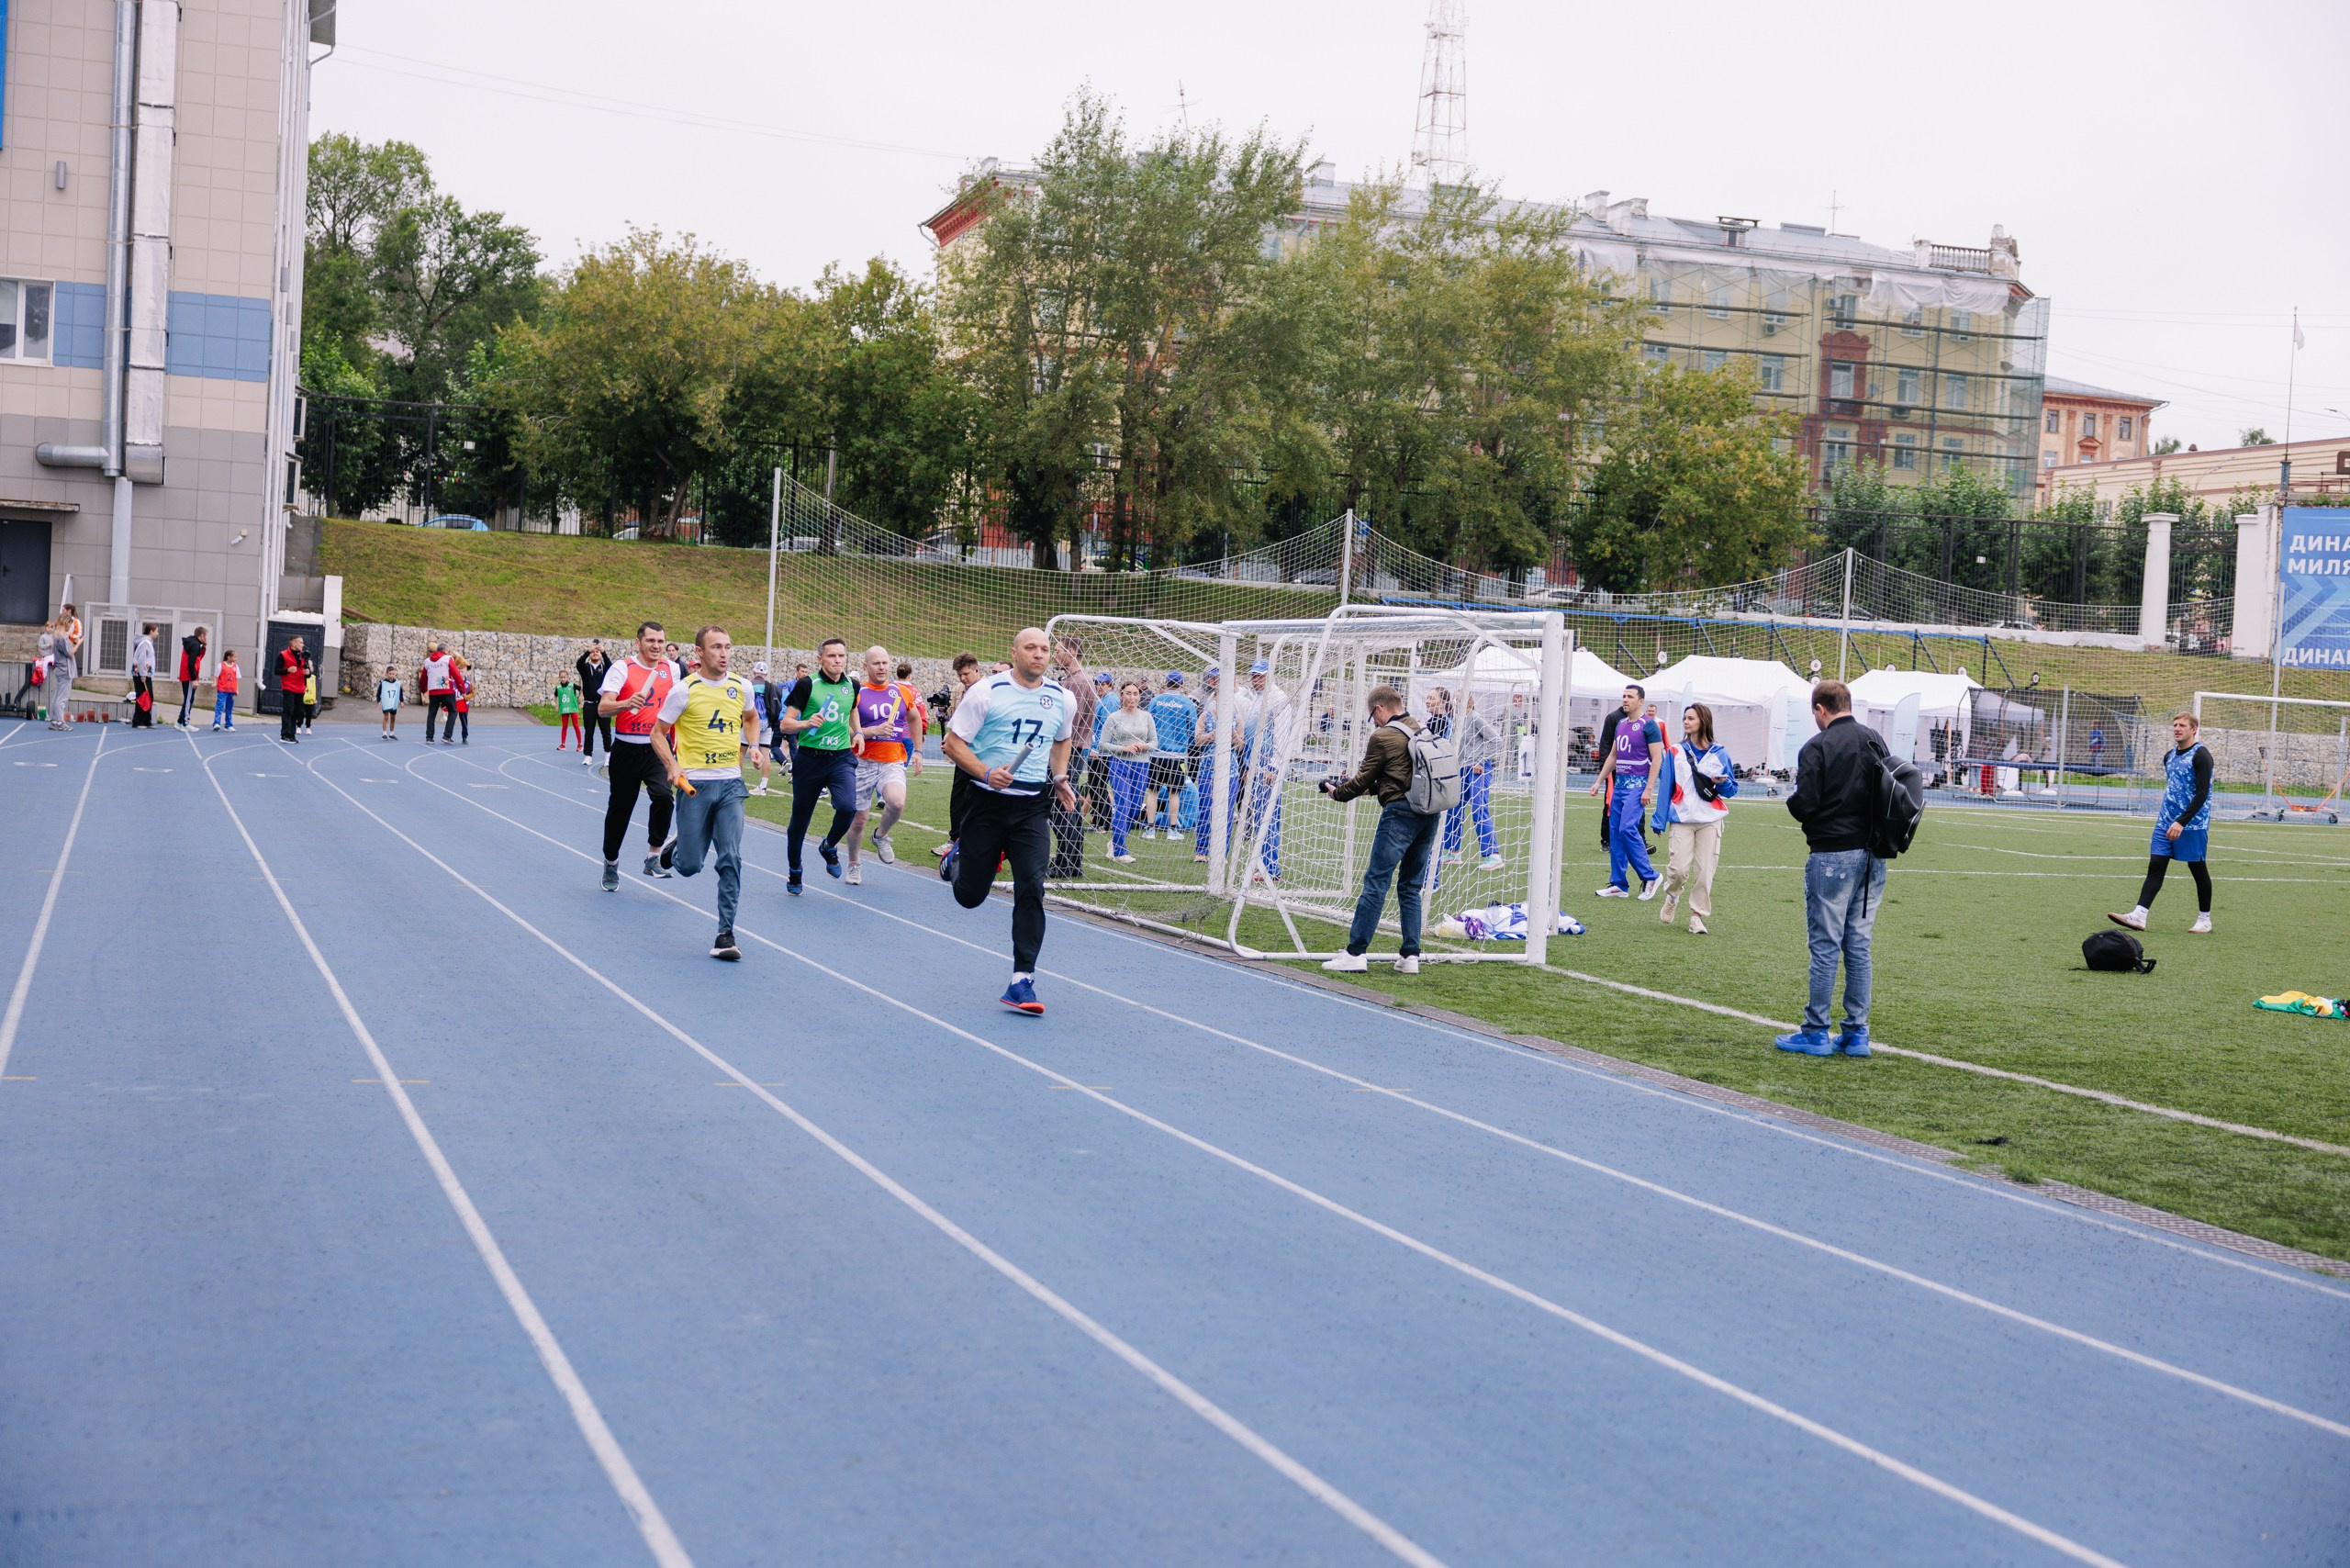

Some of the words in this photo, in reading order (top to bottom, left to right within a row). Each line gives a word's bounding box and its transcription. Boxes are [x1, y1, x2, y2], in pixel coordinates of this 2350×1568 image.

[2281, 647, 2350, 666] ДИНА
[386, 689, 396, 699] 17
[824, 700, 839, 722] 8
[869, 702, 893, 720] 10
[708, 709, 726, 733] 4
[1012, 718, 1043, 745] 17
[1617, 734, 1628, 751] 10
